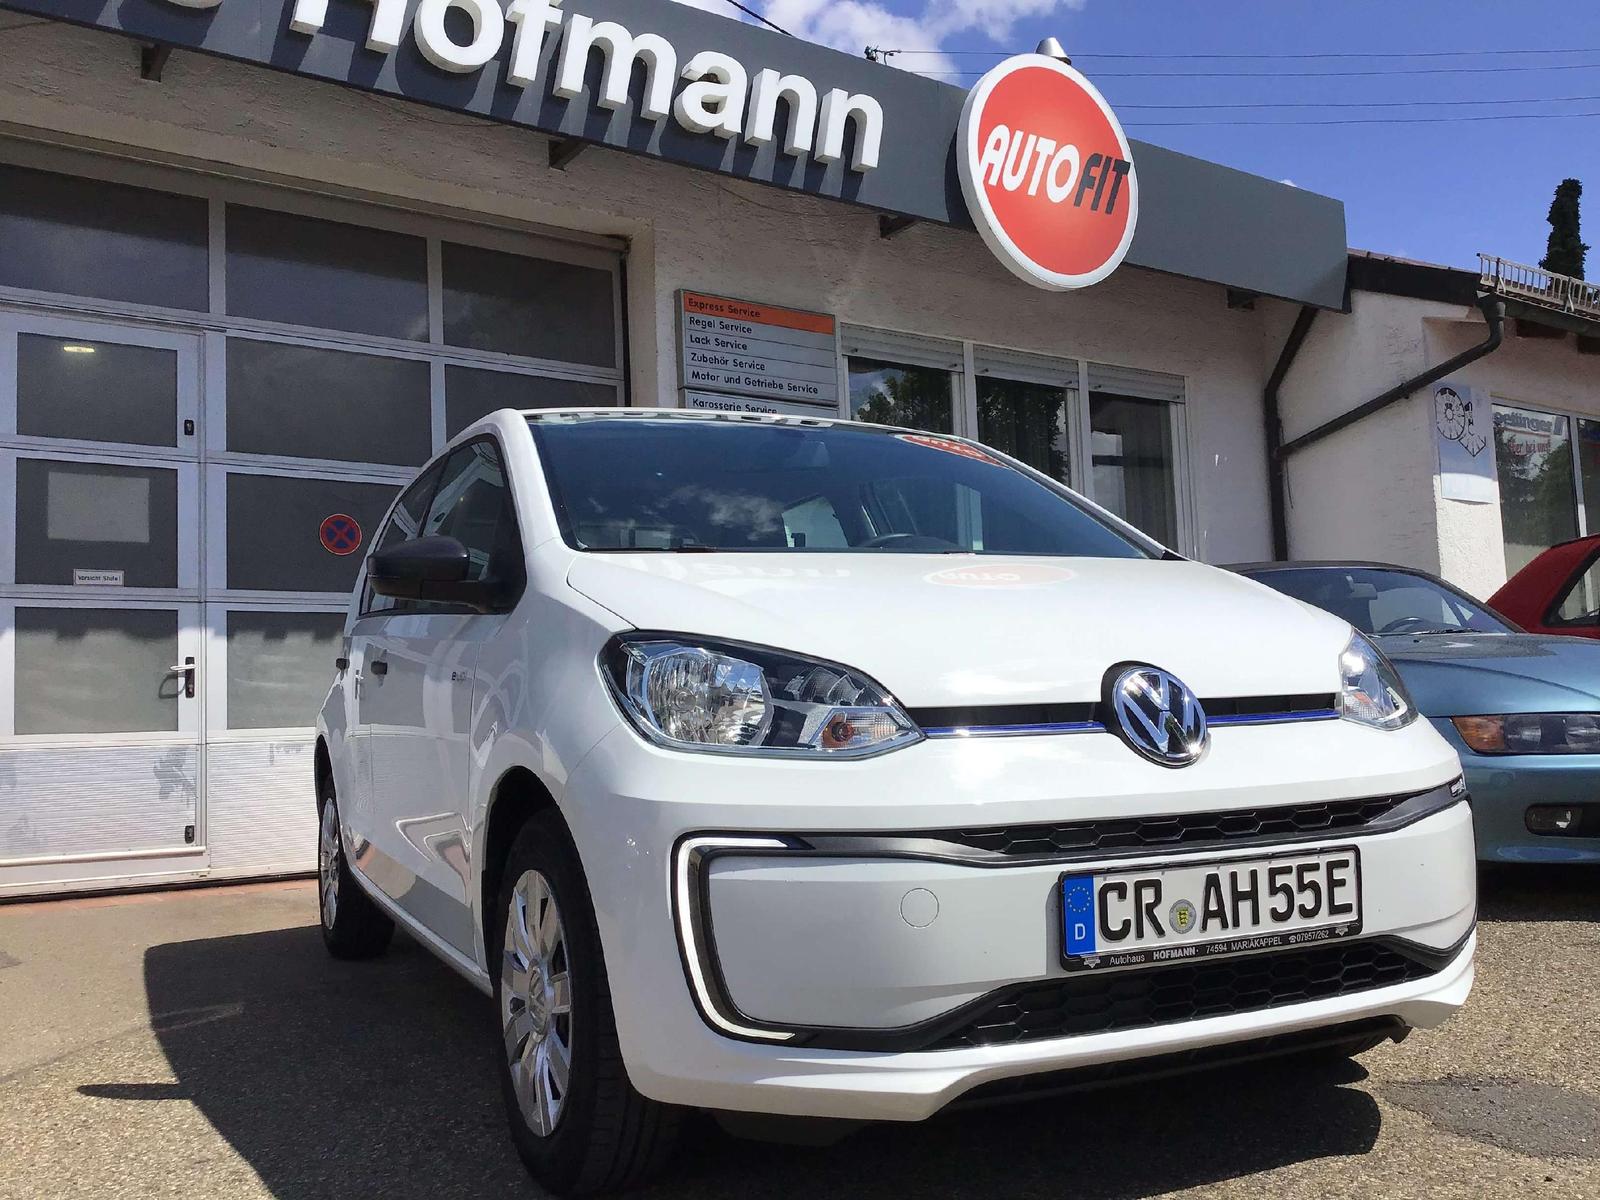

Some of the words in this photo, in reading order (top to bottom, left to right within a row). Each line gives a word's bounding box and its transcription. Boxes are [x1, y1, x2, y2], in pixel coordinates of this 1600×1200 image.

[688, 298, 724, 312] Express
[728, 305, 761, 318] Service
[689, 316, 716, 329] Regel
[719, 321, 752, 334] Service
[690, 334, 711, 345] Lack
[715, 337, 748, 351] Service
[690, 352, 729, 366] Zubehör
[733, 358, 765, 371] Service
[691, 370, 720, 382] Motor
[723, 375, 741, 385] und
[744, 377, 784, 390] Getriebe
[787, 383, 818, 394] Service
[692, 398, 742, 411] Karosserie
[745, 404, 777, 414] Service
[1098, 879, 1167, 941] CR
[1074, 923, 1086, 940] D
[1109, 953, 1145, 966] Autohaus
[1206, 943, 1228, 954] 74594
